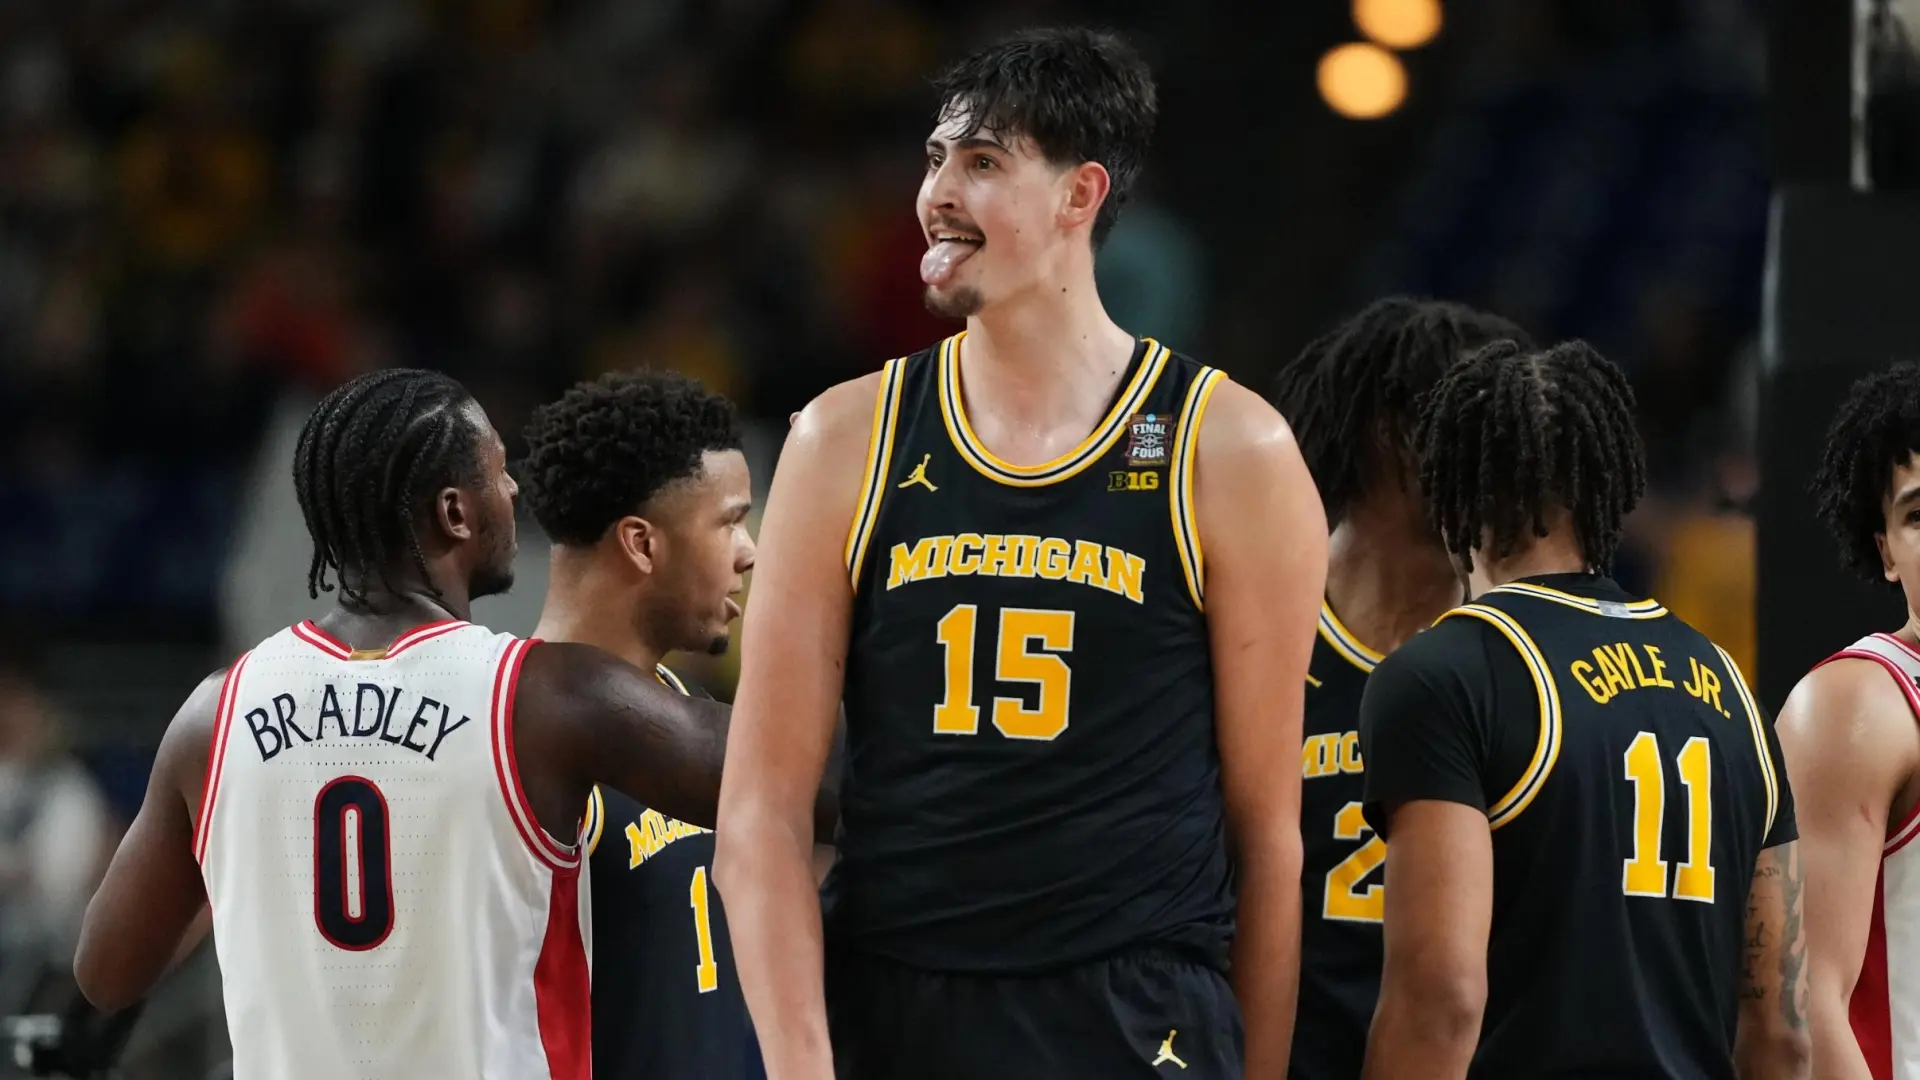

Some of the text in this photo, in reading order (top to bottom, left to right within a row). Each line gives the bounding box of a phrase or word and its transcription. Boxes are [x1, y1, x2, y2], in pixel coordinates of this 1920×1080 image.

[1131, 446, 1165, 458] FOUR
[1132, 423, 1166, 435] FINAL
[886, 533, 1146, 604] MICHIGAN
[933, 603, 1076, 741] 15
[1570, 642, 1732, 719] GAYLE JR.
[244, 682, 472, 762] BRADLEY
[1622, 731, 1715, 904] 11
[313, 774, 395, 951] 0
[690, 866, 718, 993] 1
